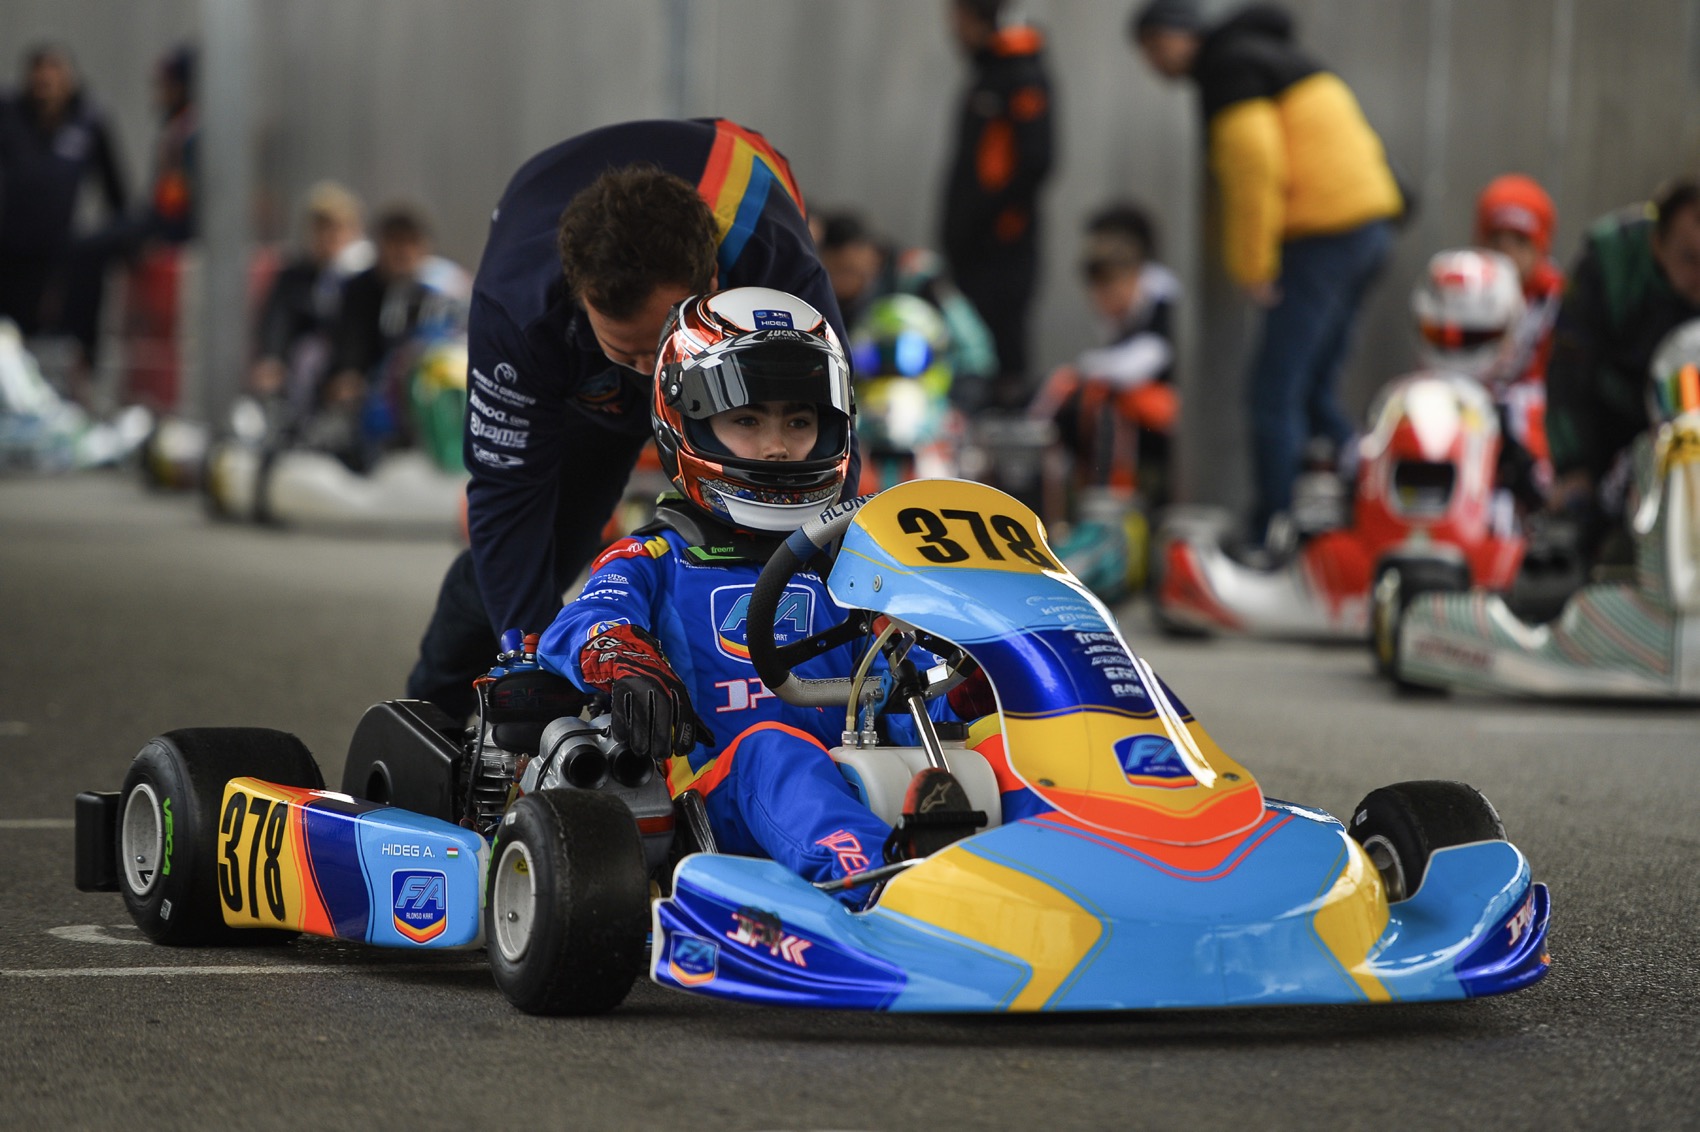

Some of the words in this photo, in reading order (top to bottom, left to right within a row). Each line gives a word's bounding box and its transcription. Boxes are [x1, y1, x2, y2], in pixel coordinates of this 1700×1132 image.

[897, 507, 1058, 570] 378
[162, 797, 174, 876] VEGA
[218, 791, 289, 922] 378
[381, 843, 420, 857] HIDEG
[422, 846, 436, 858] A.
[394, 875, 445, 910] FA
